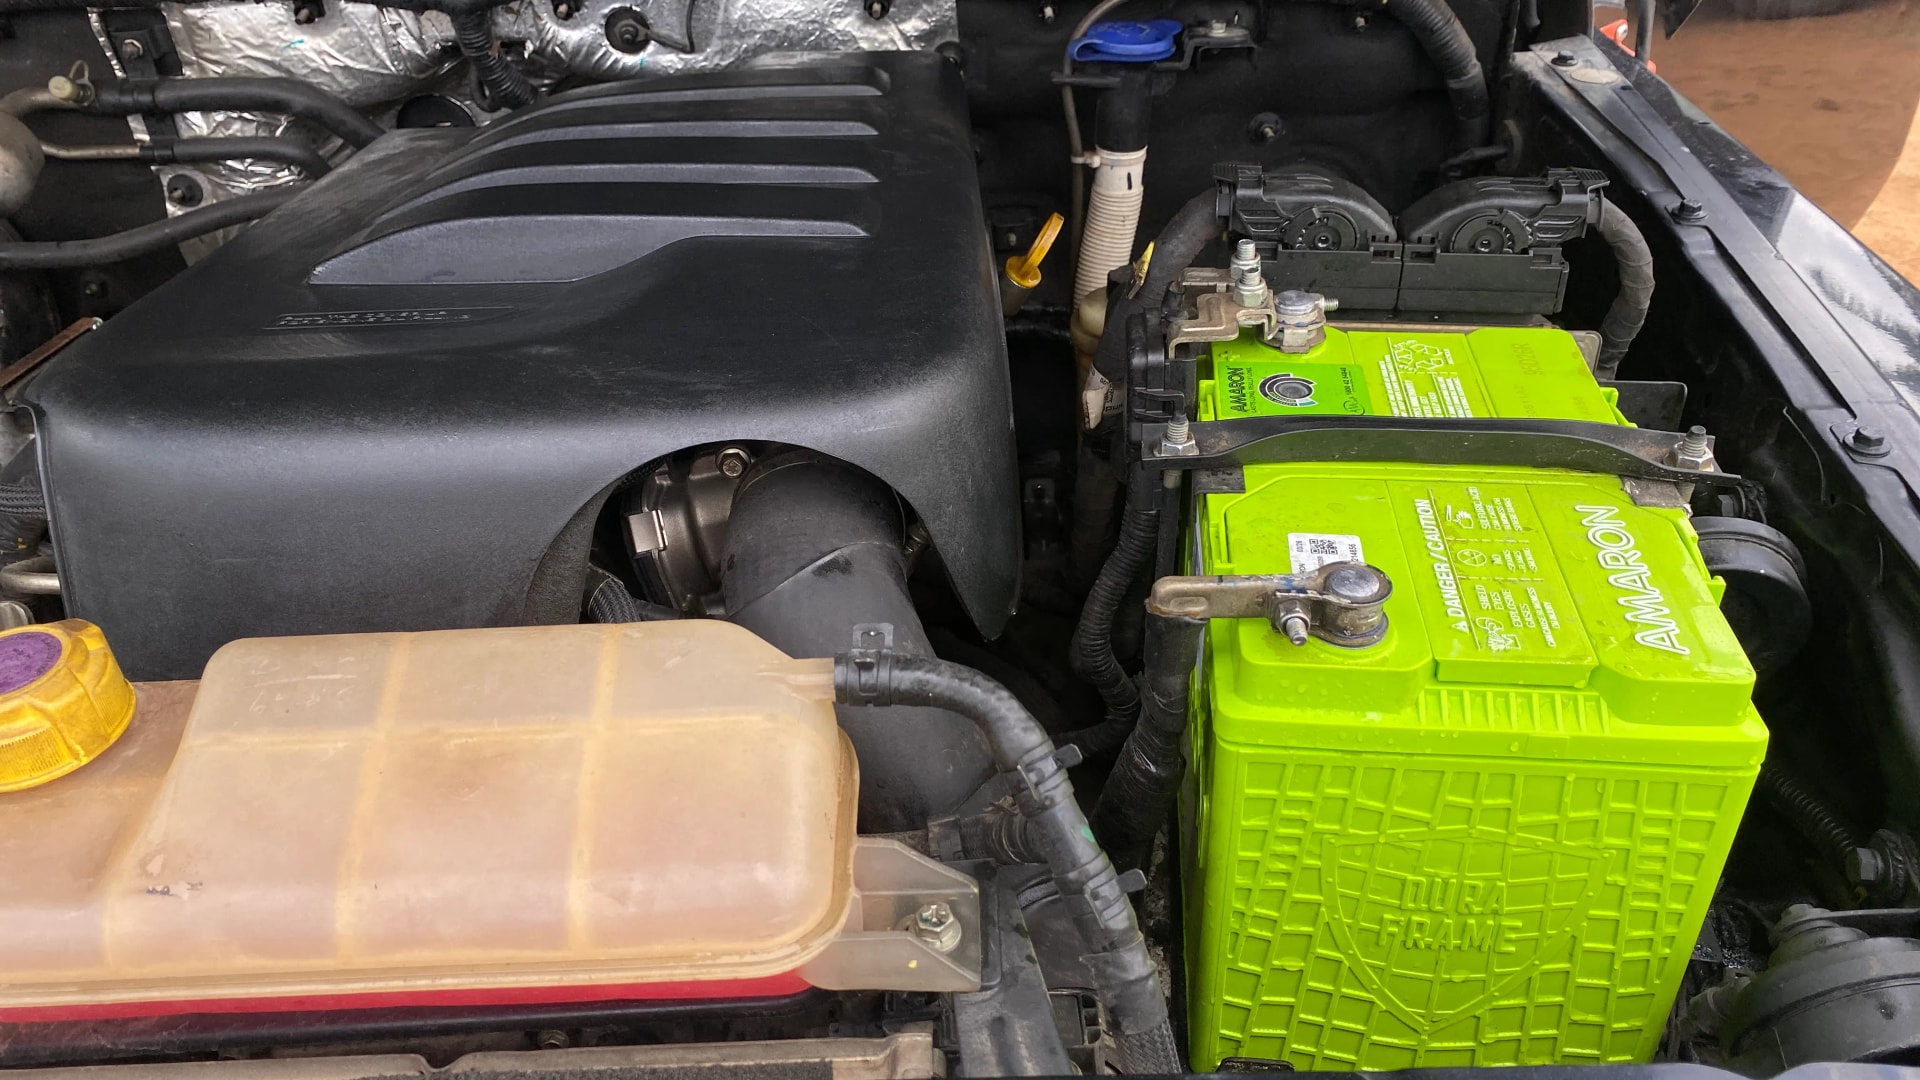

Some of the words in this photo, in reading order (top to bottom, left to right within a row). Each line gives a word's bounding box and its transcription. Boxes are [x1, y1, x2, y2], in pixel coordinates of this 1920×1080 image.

[1227, 367, 1248, 413] AMARON
[1414, 498, 1445, 551] CAUTION
[1472, 501, 1491, 530] SULFURIC
[1492, 554, 1502, 566] NO
[1574, 505, 1690, 655] AMARON
[1433, 561, 1465, 617] DANGER
[1475, 584, 1491, 610] SHIELD
[1490, 591, 1504, 610] EYES
[1501, 588, 1523, 628] EXPLOSIVE
[1520, 603, 1535, 629] GASES
[1400, 875, 1506, 915] DURA
[1379, 913, 1522, 953] FRAME
